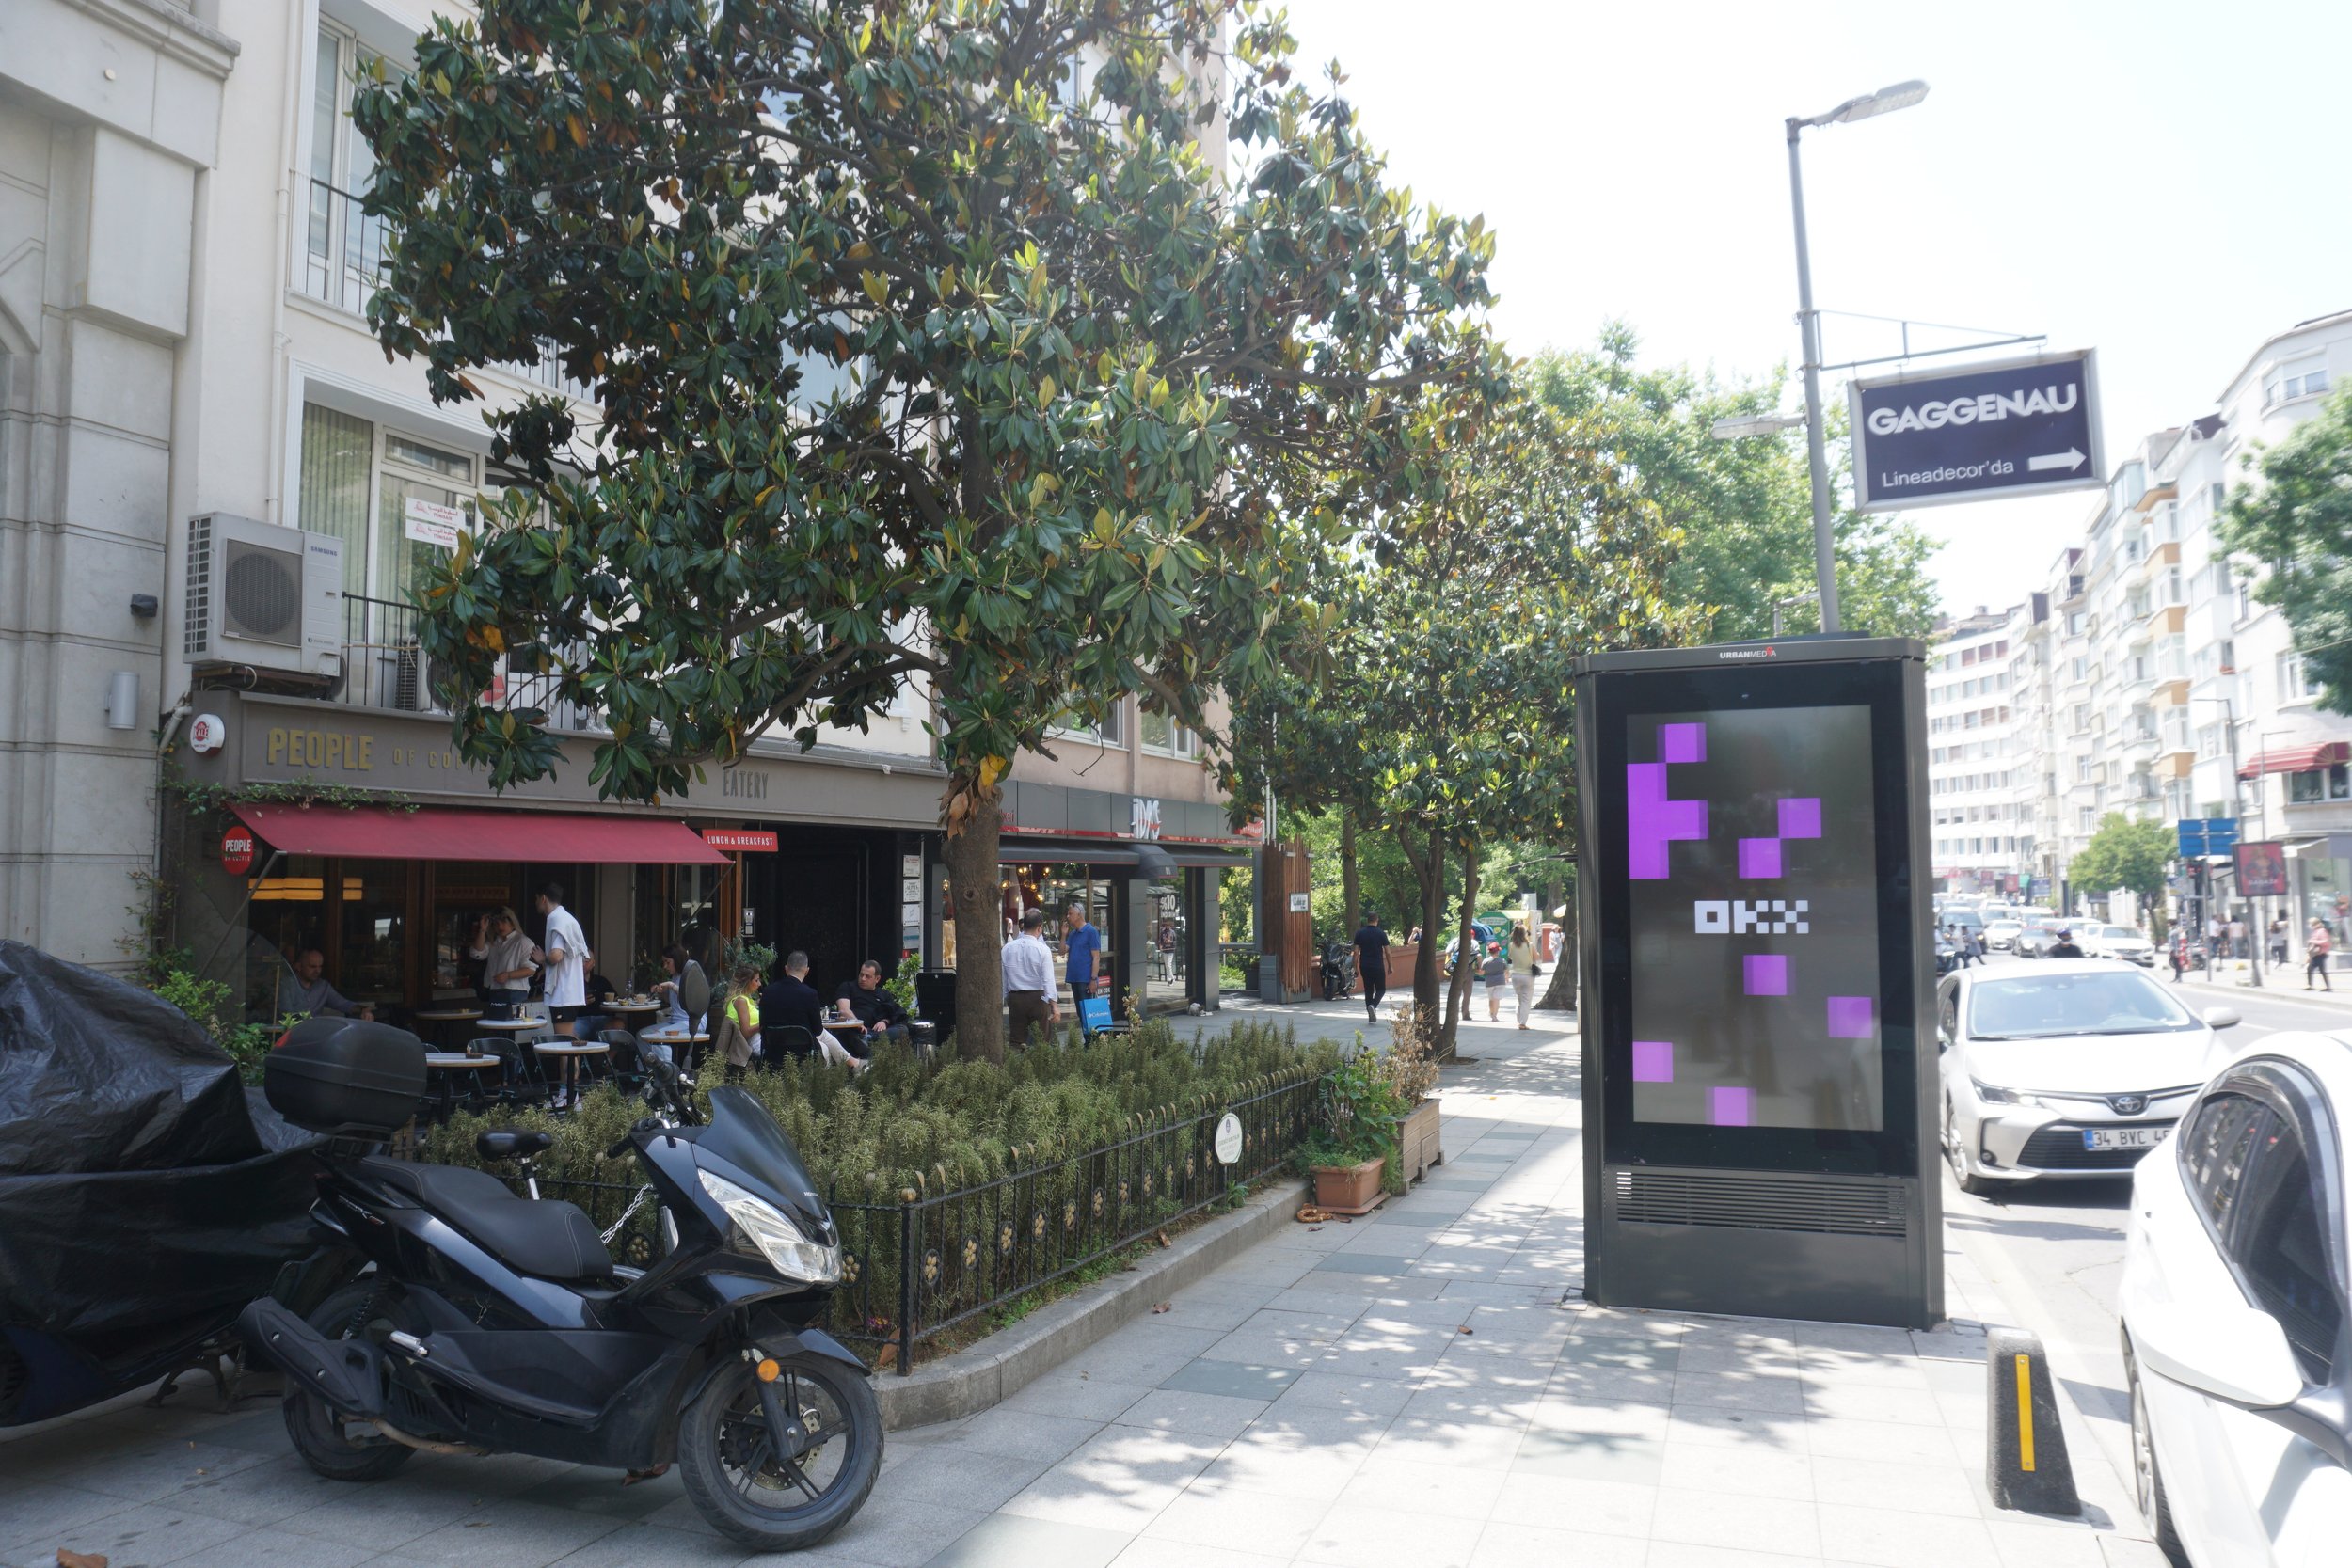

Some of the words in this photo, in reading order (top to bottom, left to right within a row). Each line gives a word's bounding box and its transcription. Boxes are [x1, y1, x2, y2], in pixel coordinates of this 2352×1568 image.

[1868, 383, 2077, 436] GAGGENAU
[1883, 459, 2014, 487] Lineadecor'da
[310, 546, 338, 557] SAMSUNG
[267, 727, 373, 771] PEOPLE
[392, 748, 414, 767] OF
[723, 769, 769, 800] EATERY
[225, 839, 252, 853] PEOPLE
[707, 835, 729, 845] LUNCH
[738, 836, 773, 846] BREAKFAST
[1694, 900, 1809, 934] OKX
[2094, 1132, 2111, 1146] 34
[2119, 1131, 2146, 1145] BVC
